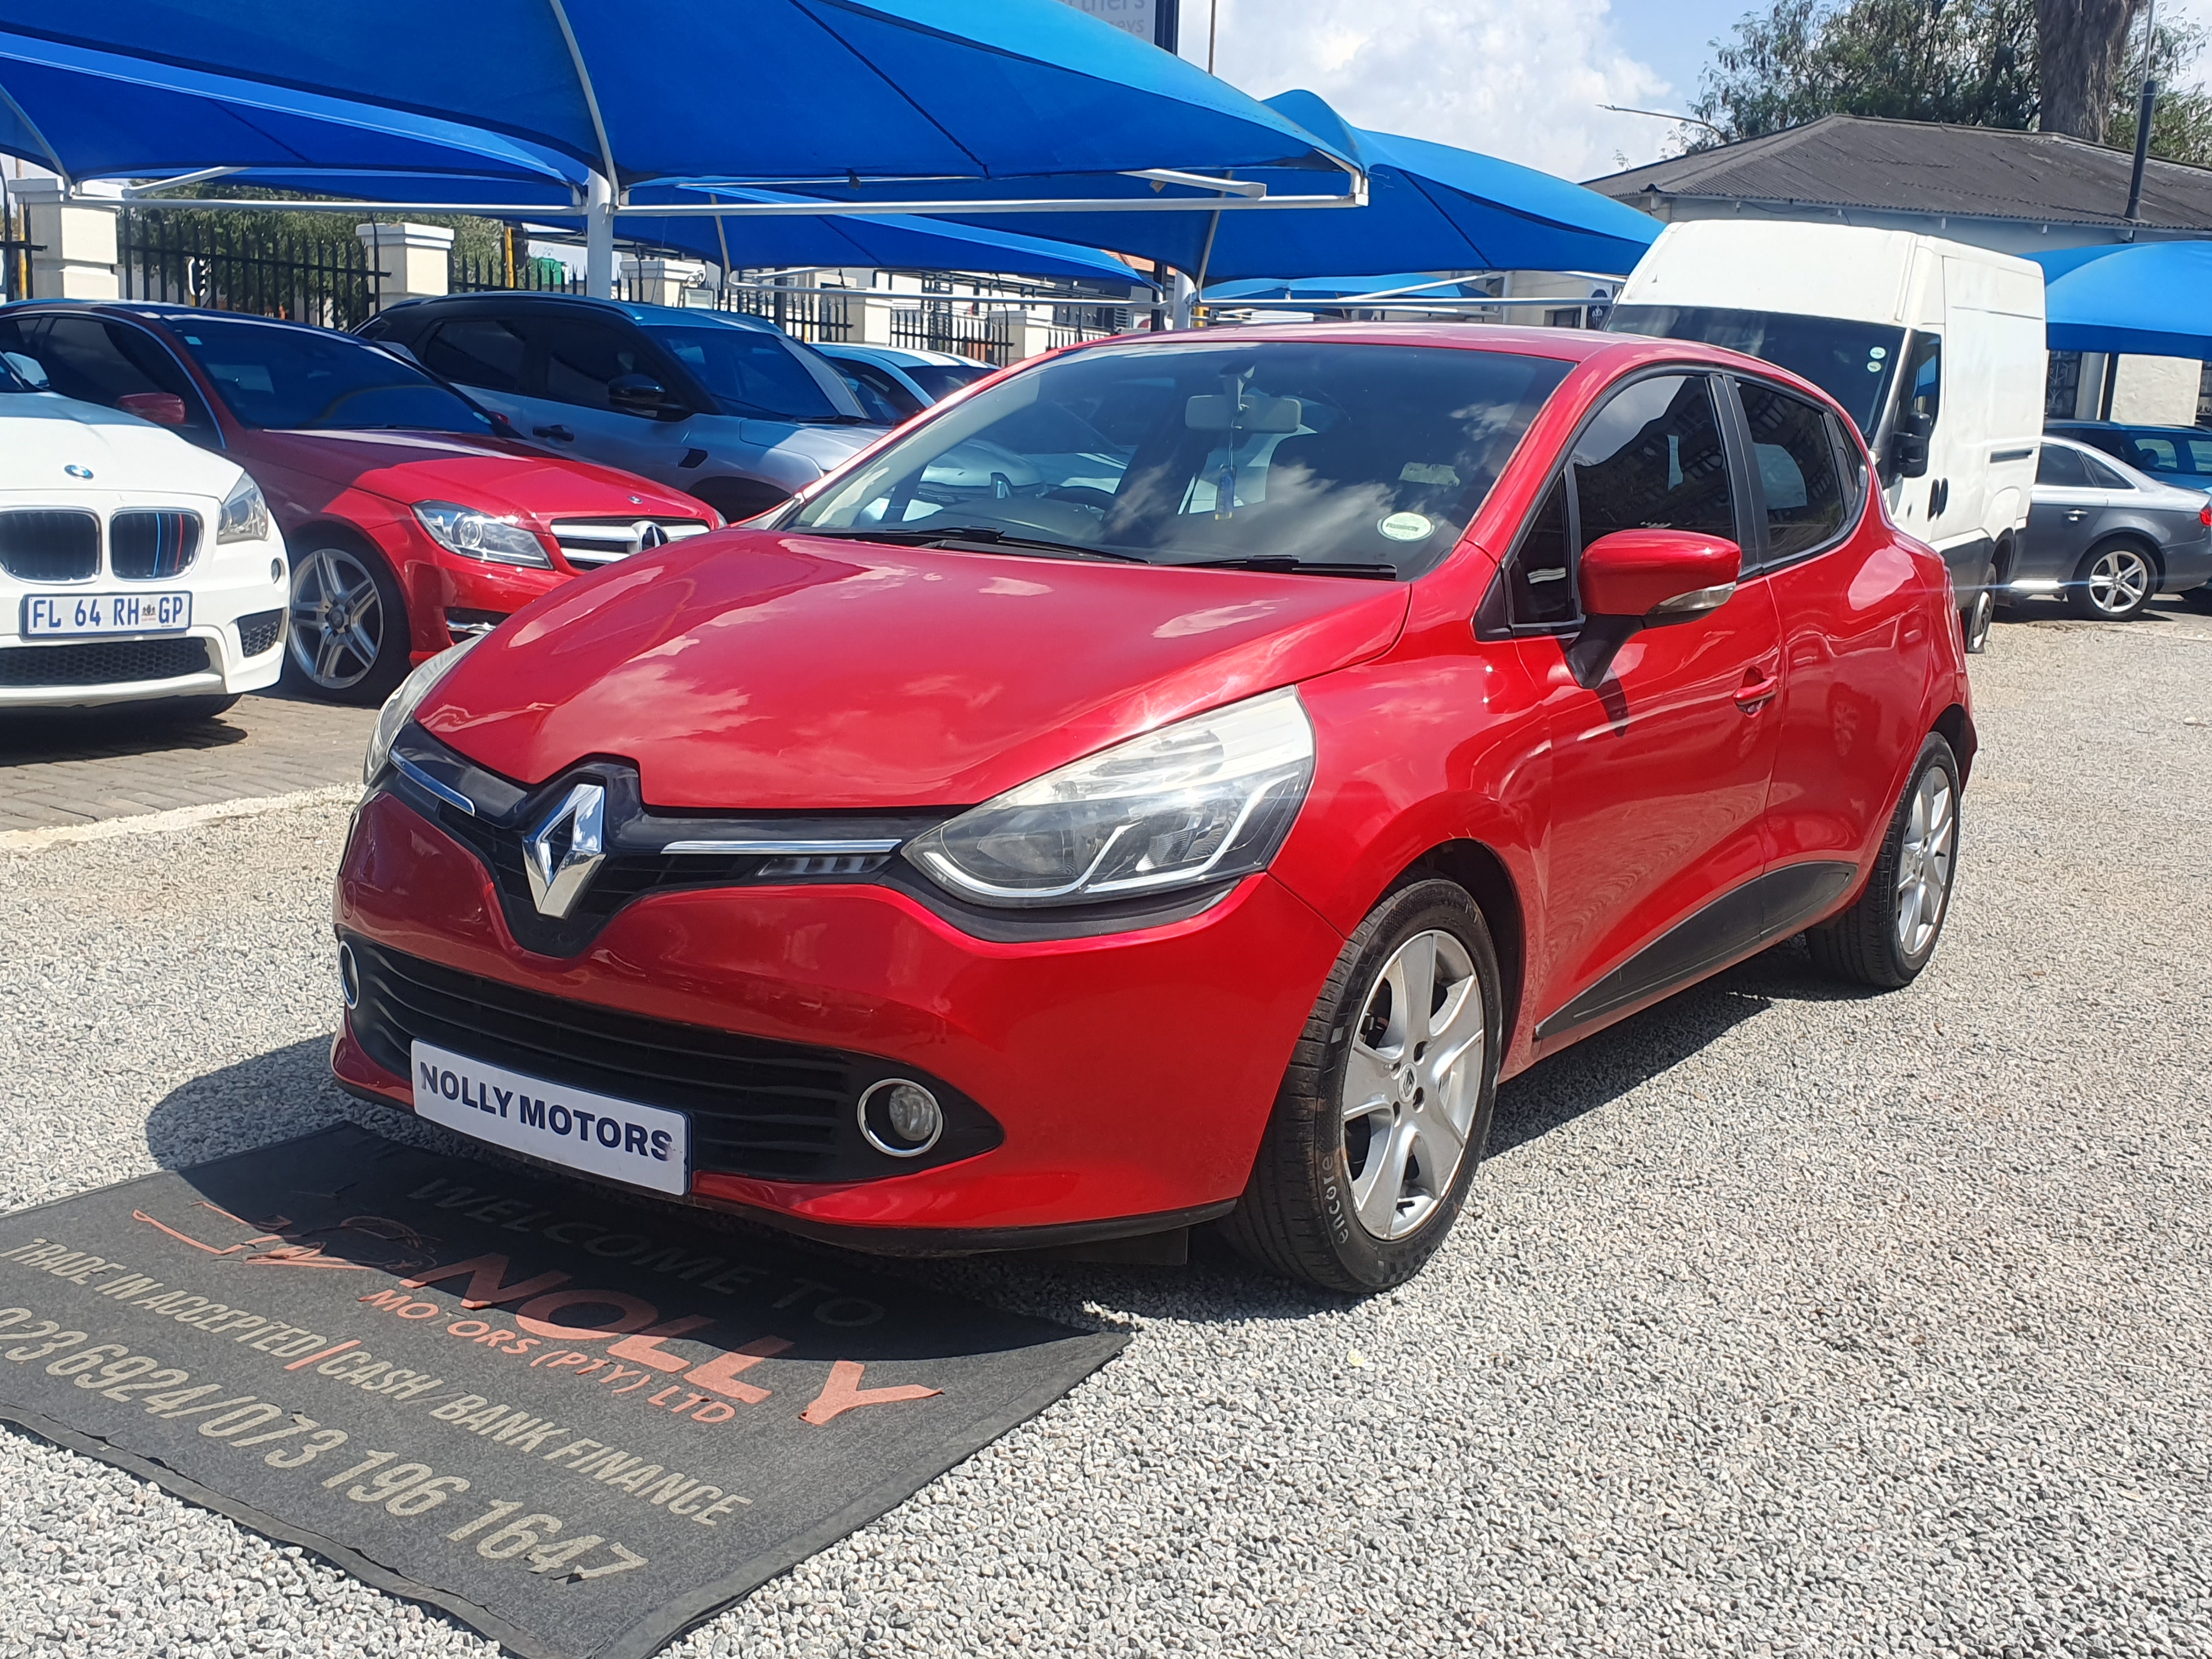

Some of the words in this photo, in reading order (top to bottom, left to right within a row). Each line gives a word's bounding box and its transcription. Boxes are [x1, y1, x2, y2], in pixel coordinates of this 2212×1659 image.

[33, 599, 61, 629] FL
[75, 599, 101, 627] 64
[114, 597, 139, 627] RH
[159, 596, 183, 624] GP
[420, 1062, 514, 1119] NOLLY
[520, 1095, 674, 1162] MOTORS
[405, 1177, 768, 1296] WELCOME
[771, 1276, 887, 1328] TO
[1322, 1155, 1349, 1244] encore
[0, 1238, 127, 1285] TRADE
[94, 1272, 164, 1300] IN
[543, 1437, 753, 1526] FINANCE
[358, 1289, 541, 1354] MOTORS
[647, 1385, 736, 1423] LTD
[399, 1252, 945, 1427] NOLLY
[320, 1449, 471, 1516] 196
[445, 1499, 649, 1581] 1647
